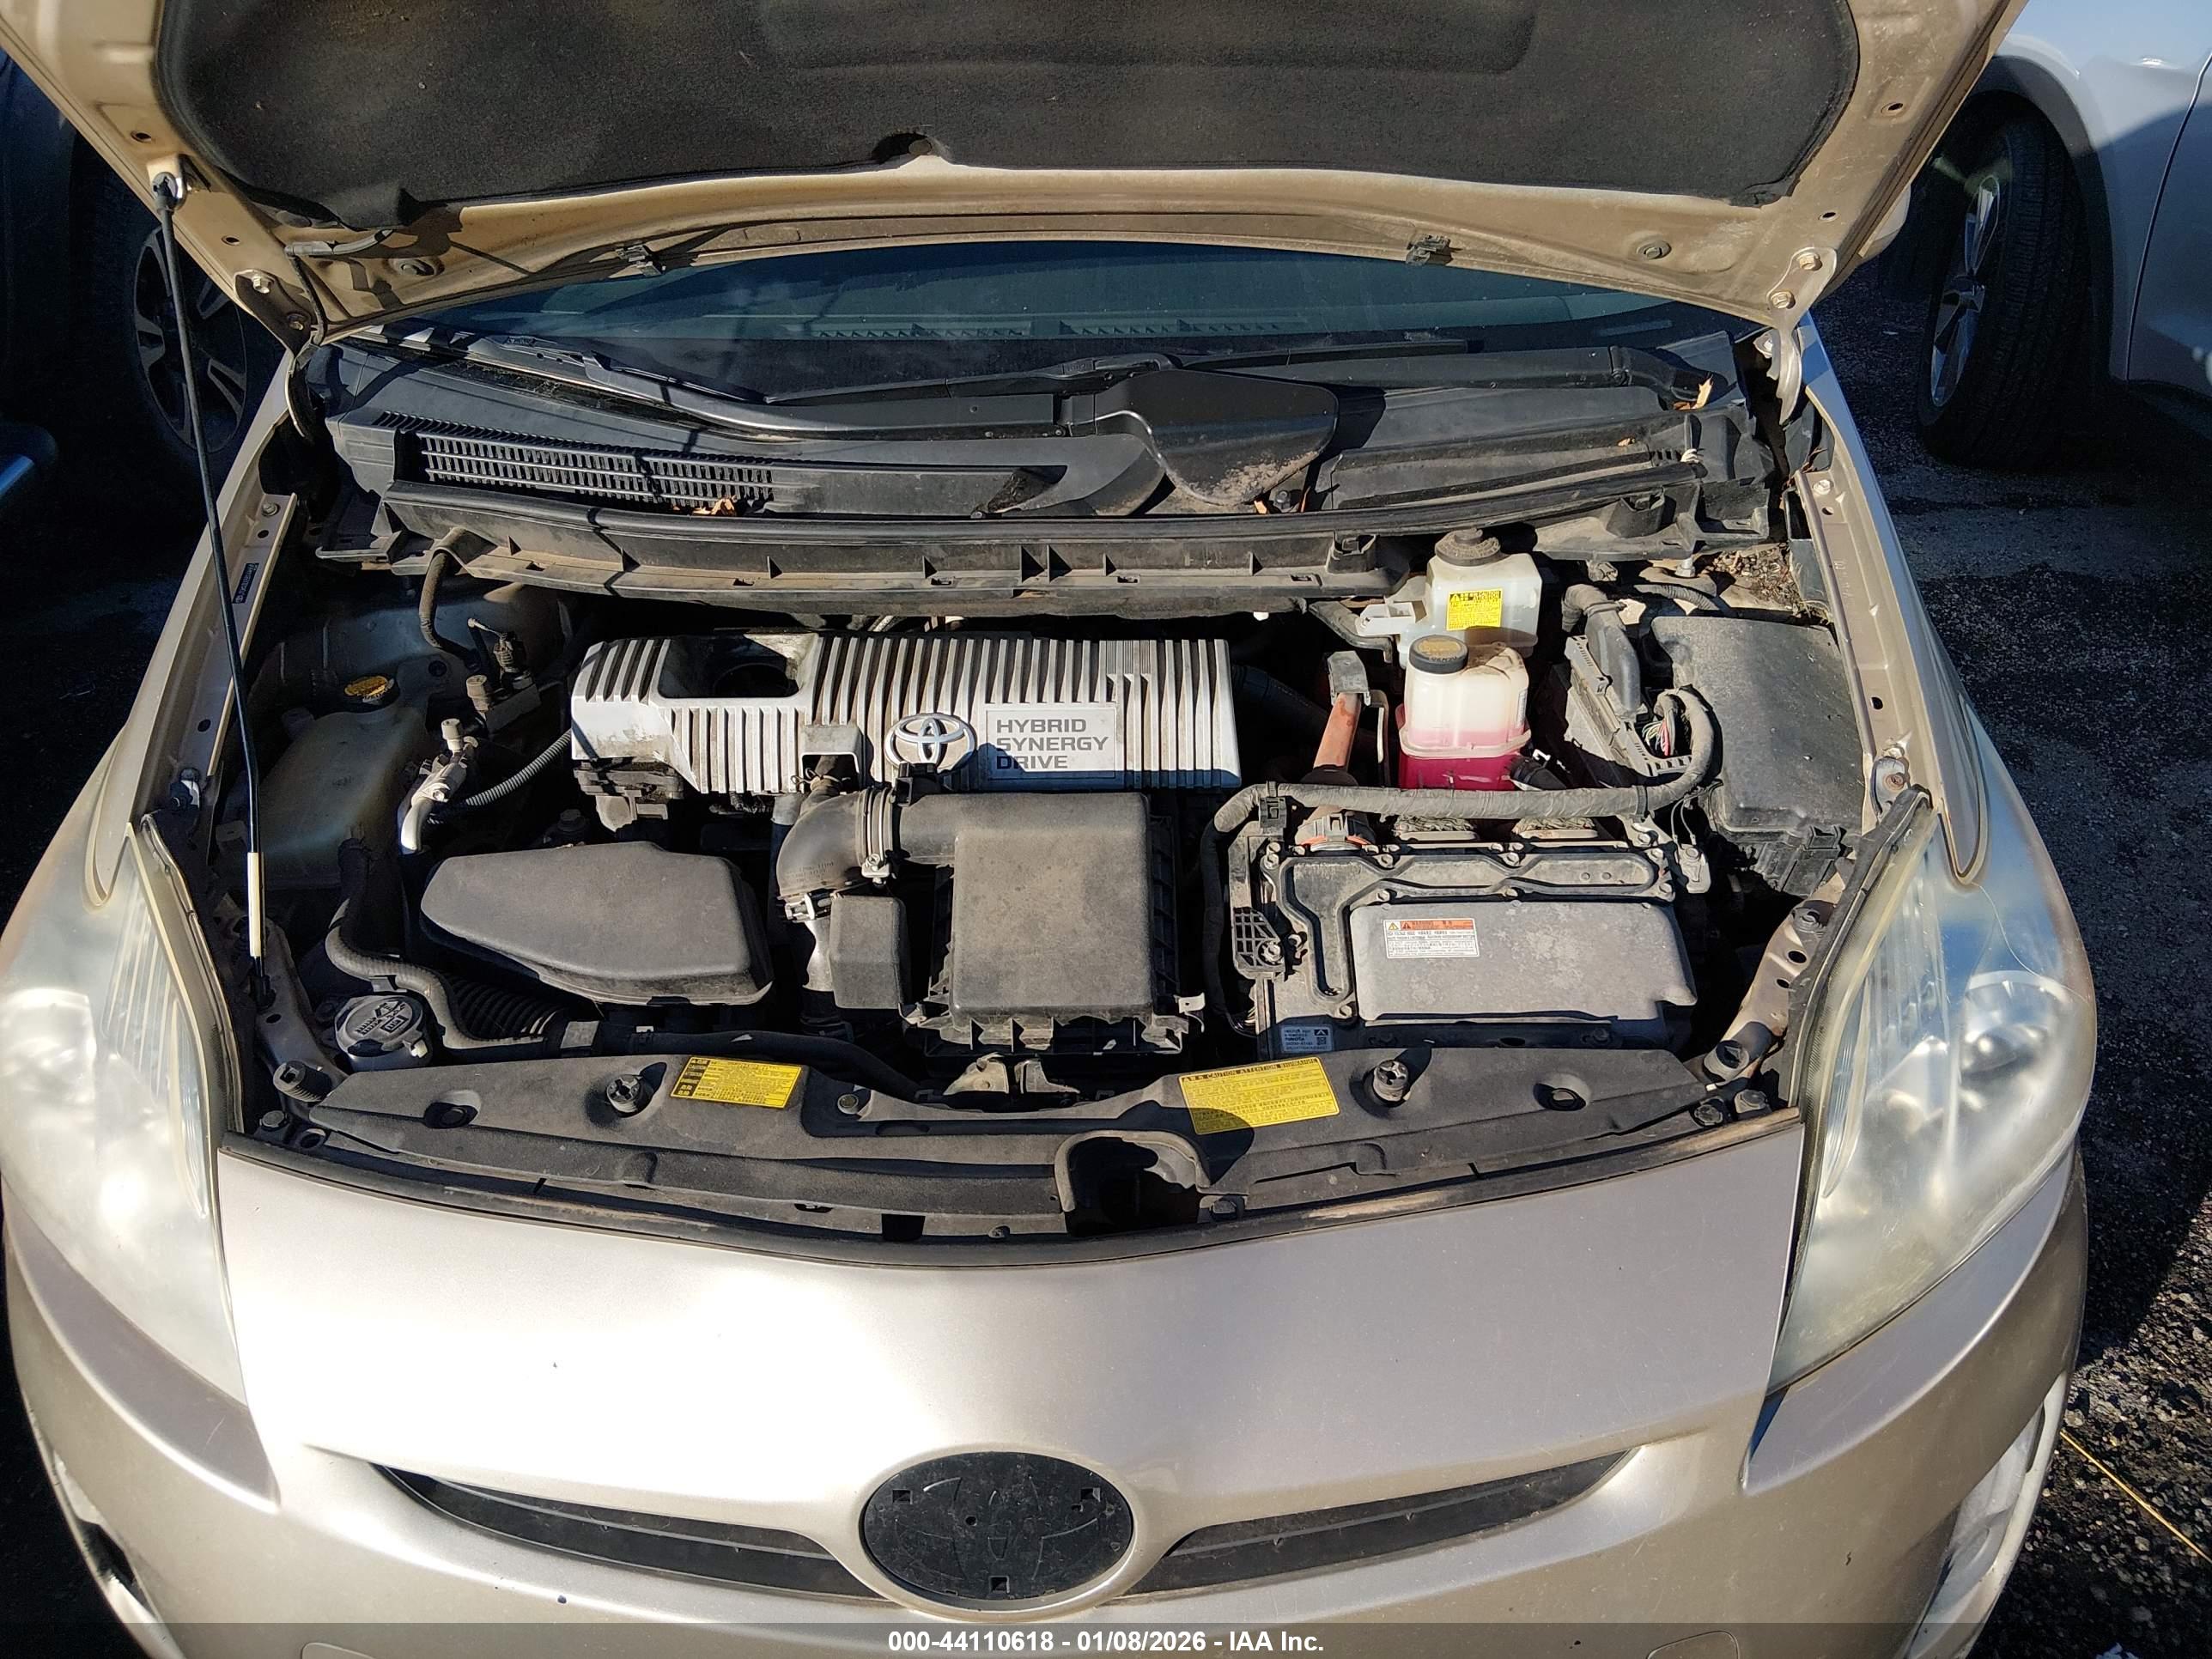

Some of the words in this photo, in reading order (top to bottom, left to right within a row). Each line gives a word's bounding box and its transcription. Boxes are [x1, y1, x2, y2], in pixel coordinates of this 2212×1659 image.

[996, 719, 1087, 733] HYBRID
[996, 736, 1109, 751] SYNERGY
[996, 755, 1068, 770] DRIVE
[1207, 1070, 1237, 1079] CAUTION
[1240, 1064, 1277, 1074] ATTENTION
